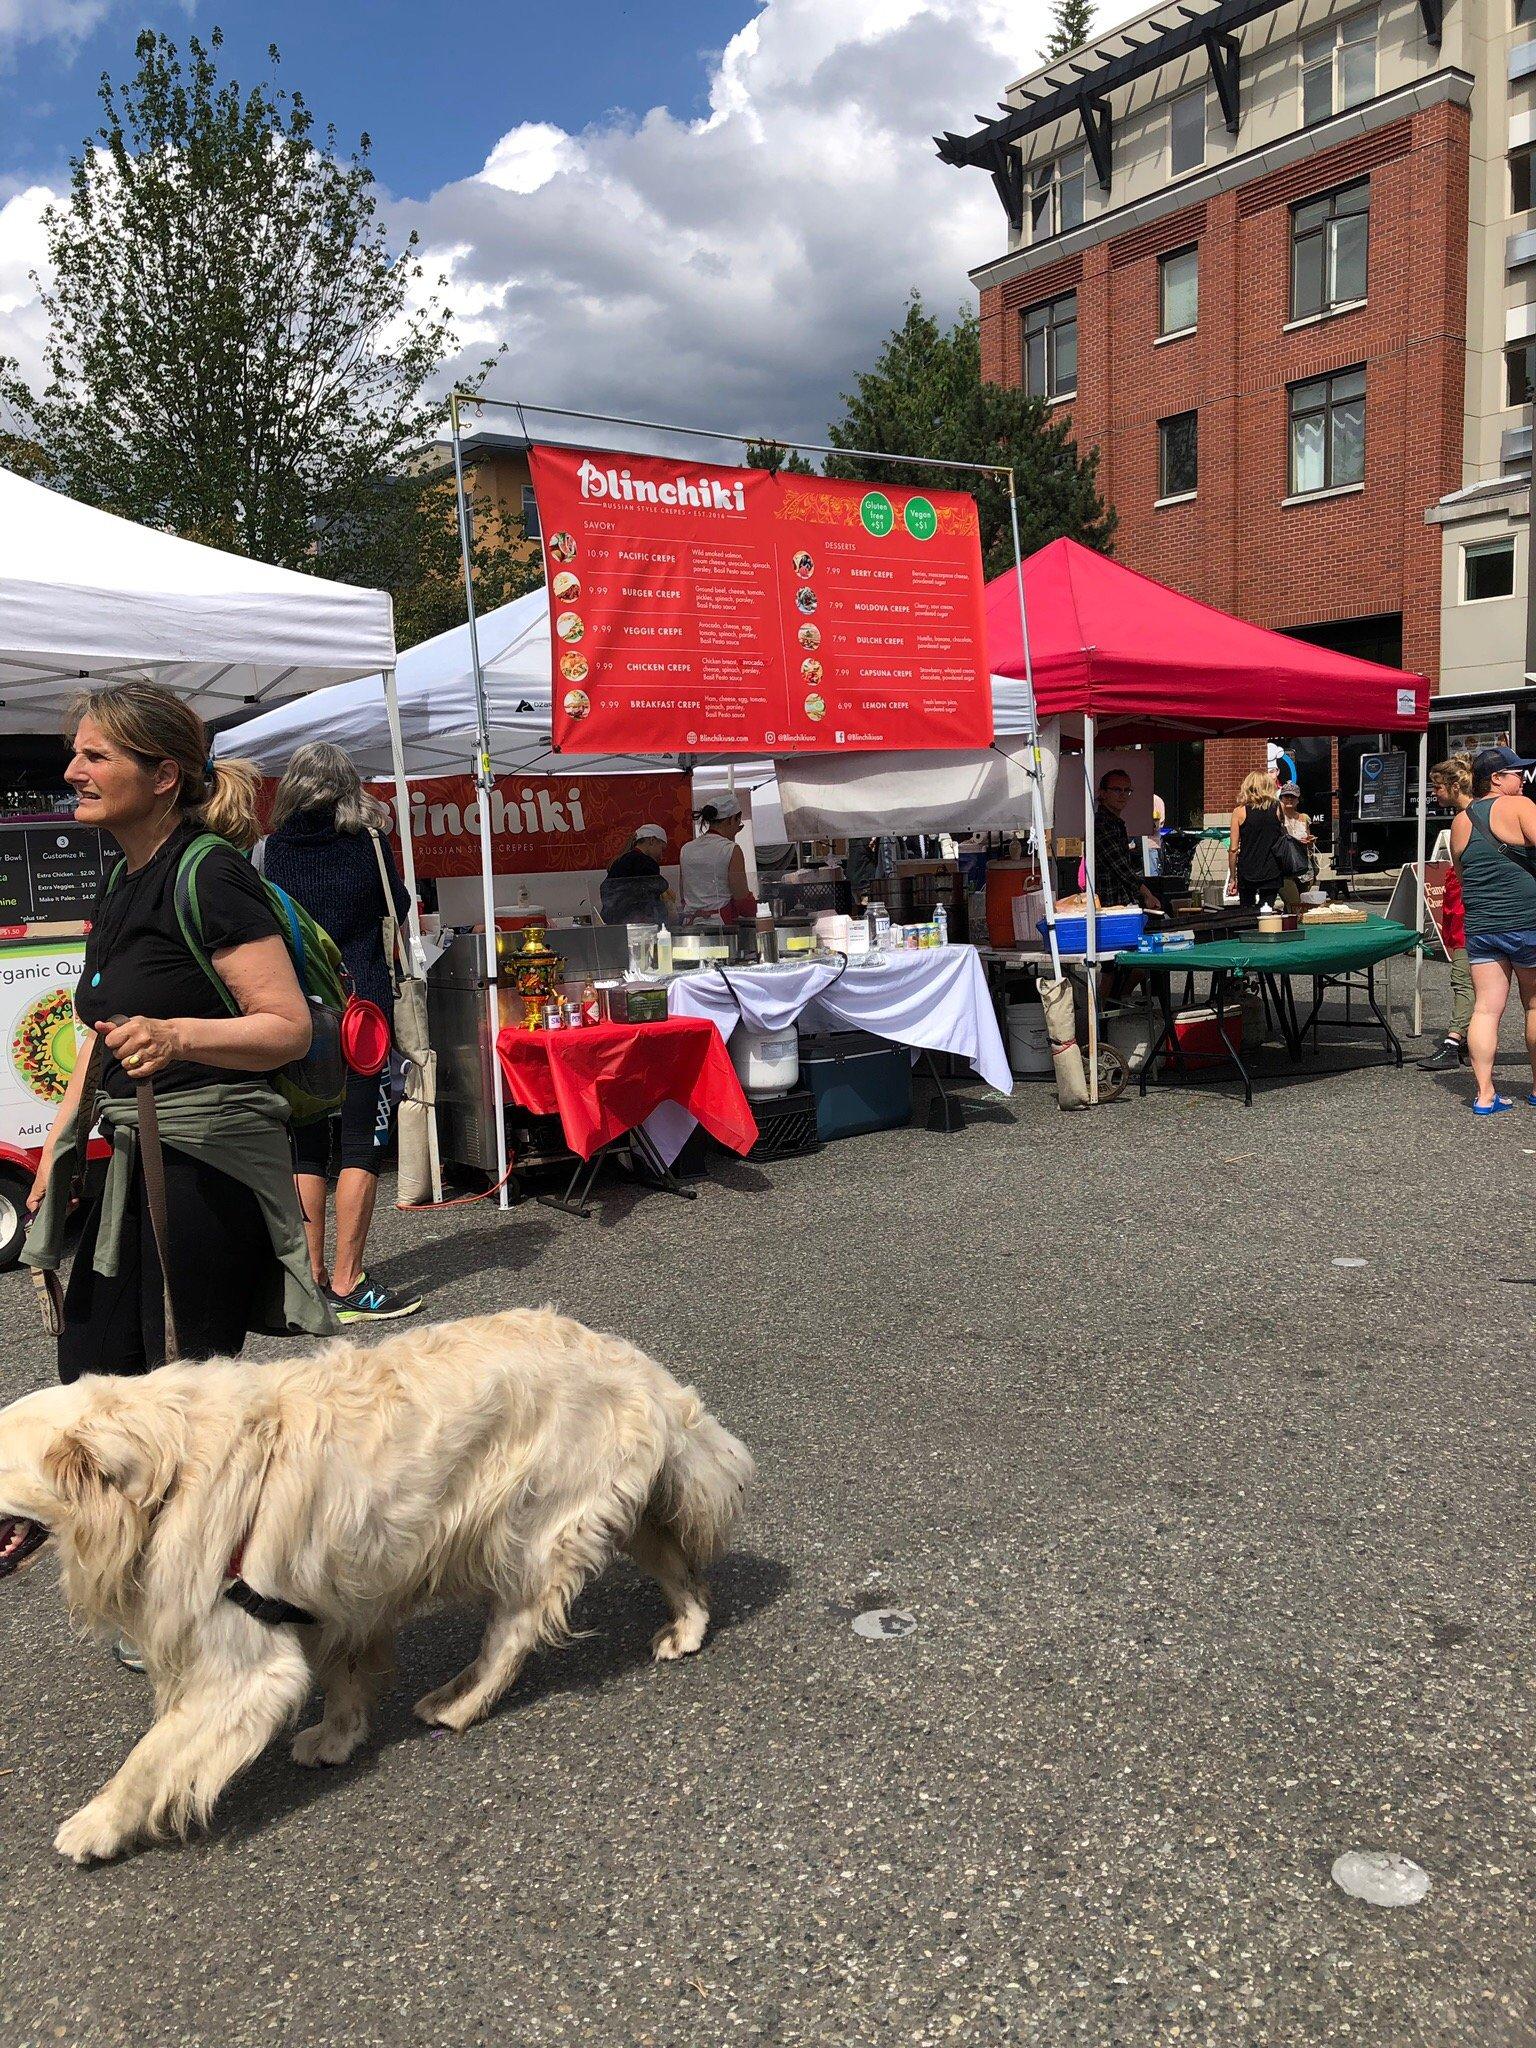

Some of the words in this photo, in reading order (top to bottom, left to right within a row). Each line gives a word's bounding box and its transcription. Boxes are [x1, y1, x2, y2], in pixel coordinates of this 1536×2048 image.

[577, 459, 746, 511] Blinchiki
[602, 502, 634, 511] RUSSIAN
[661, 507, 685, 516] CREPES
[866, 501, 887, 510] Gluten
[870, 511, 883, 519] free
[910, 510, 931, 519] Vegan
[584, 519, 616, 532] SAVORY
[871, 521, 883, 529] +$1
[825, 542, 856, 550] DESSERTS
[588, 550, 609, 558] 10.99
[619, 551, 649, 561] PACIFIC
[652, 554, 675, 563] CREPE
[851, 569, 871, 577] BERRY
[874, 571, 893, 579] CREPE
[589, 587, 608, 595] 9.99
[622, 588, 653, 598] BURGER
[656, 590, 680, 598] CREPE
[695, 585, 713, 593] Ground
[728, 587, 746, 595] cheese,
[855, 604, 888, 612] MOLDOVA
[592, 625, 611, 633] 9.99
[624, 627, 655, 635] VEGGIE
[658, 627, 682, 635] CREPE
[627, 663, 664, 671] CHICKEN
[667, 664, 691, 672] CREPE
[860, 669, 891, 677] CAPSUNA
[677, 701, 700, 709] CREPE
[377, 788, 585, 837] inchiki
[1312, 814, 1324, 822] ME
[419, 846, 462, 855] RUSSIAN
[499, 844, 534, 852] CREPES
[19, 1124, 41, 1136] Add
